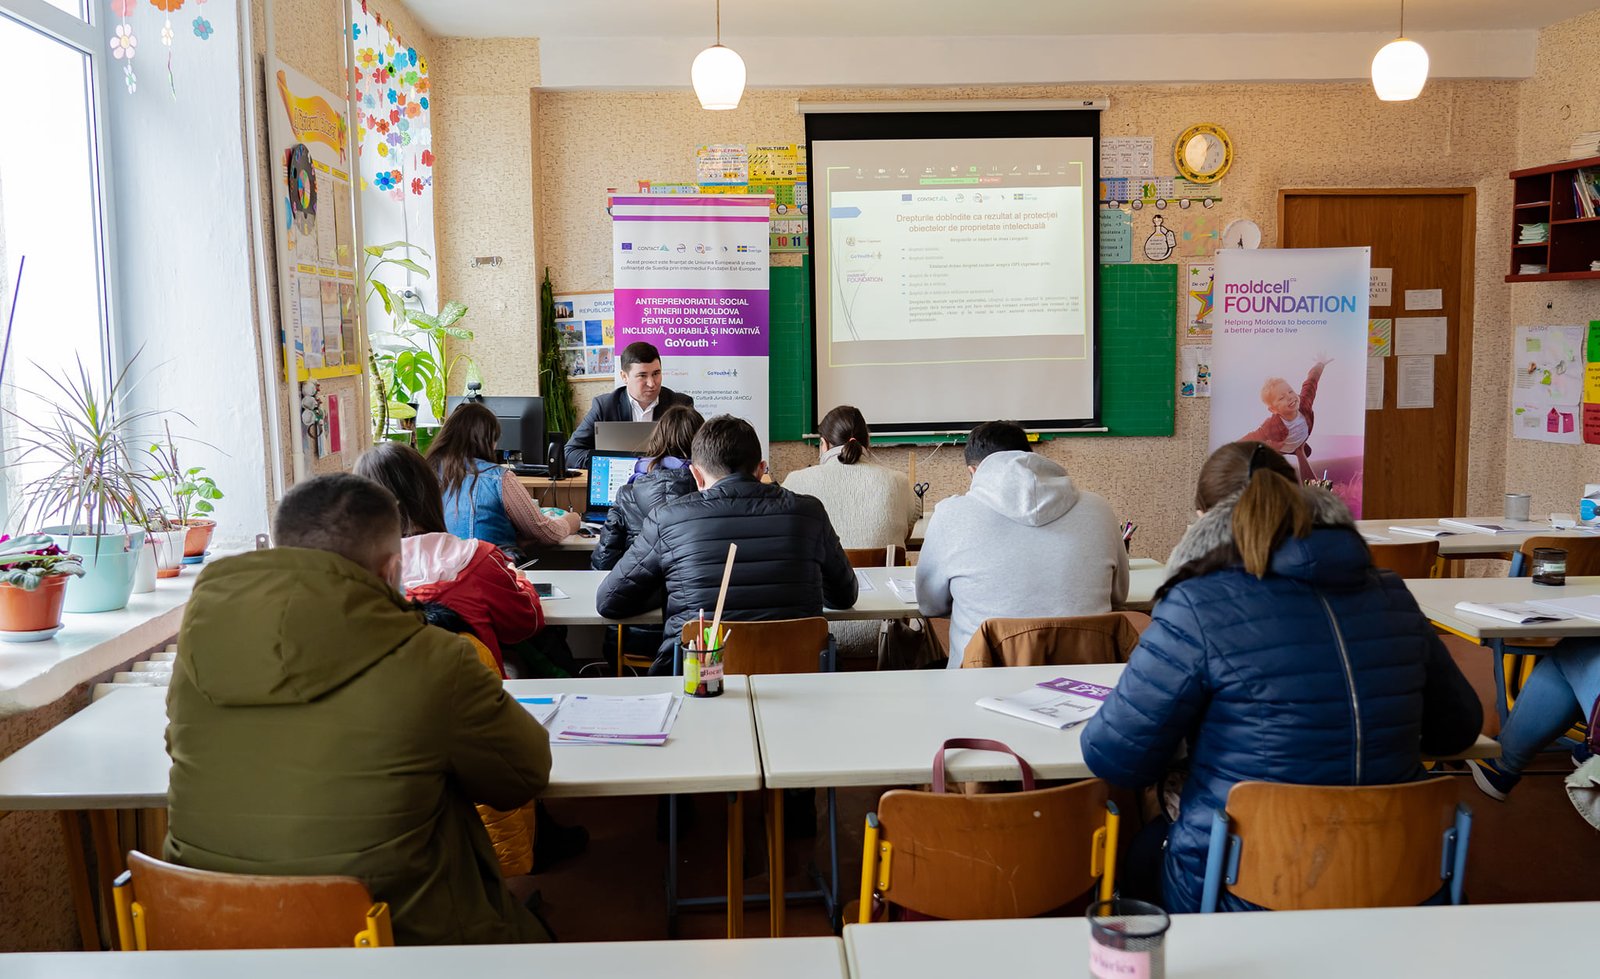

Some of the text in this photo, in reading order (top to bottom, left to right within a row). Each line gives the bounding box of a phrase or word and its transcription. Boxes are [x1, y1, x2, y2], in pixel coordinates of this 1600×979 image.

[896, 214, 934, 223] Drepturile
[984, 212, 1012, 220] rezultat
[909, 224, 946, 232] obiectelor
[960, 223, 1001, 232] proprietate
[777, 236, 787, 247] 10
[792, 236, 801, 246] 11
[1225, 280, 1289, 294] moldcell
[1224, 296, 1356, 313] FOUNDATION
[644, 308, 652, 316] ȘI
[622, 326, 760, 336] INCLUSIVĂ, DURABILĂ ȘI INOVATIVĂ
[664, 339, 708, 347] GoYouth
